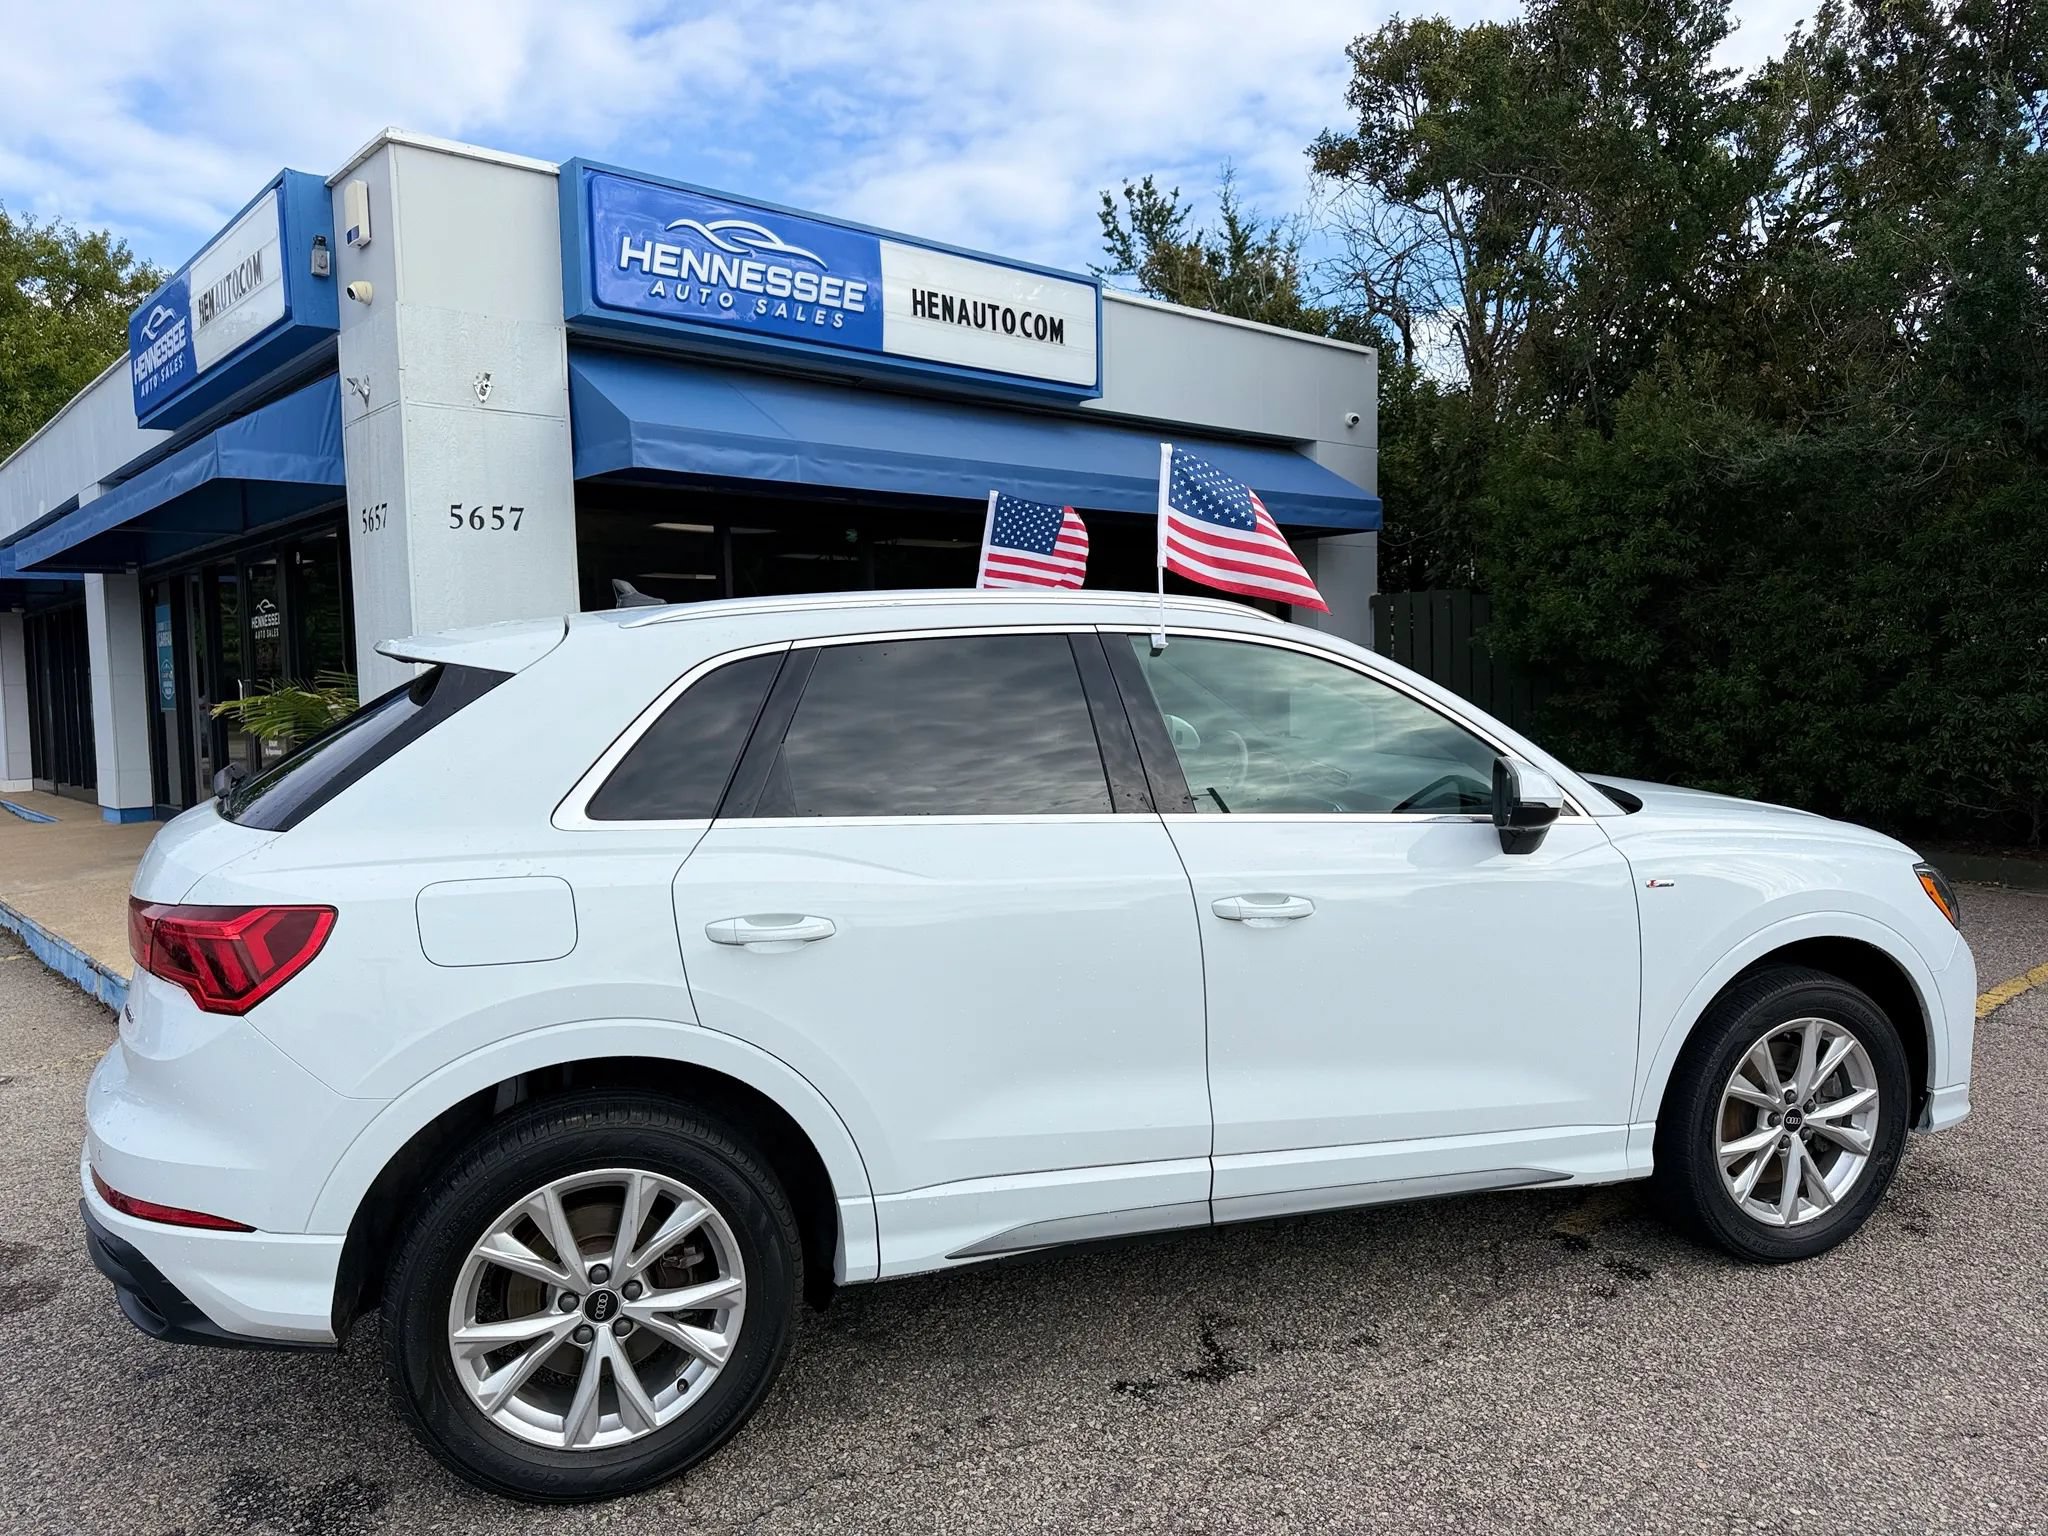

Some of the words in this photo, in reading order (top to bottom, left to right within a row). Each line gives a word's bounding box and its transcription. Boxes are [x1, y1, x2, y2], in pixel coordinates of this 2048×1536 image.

[198, 249, 263, 328] HENAUTO.COM
[620, 236, 868, 313] HENNESSEE
[651, 280, 734, 308] AUTO
[756, 299, 845, 328] SALES
[133, 315, 187, 385] HENNESSEE
[140, 375, 158, 398] AUTO
[160, 354, 184, 383] SALES
[361, 502, 388, 534] 5657
[449, 503, 525, 532] 5657
